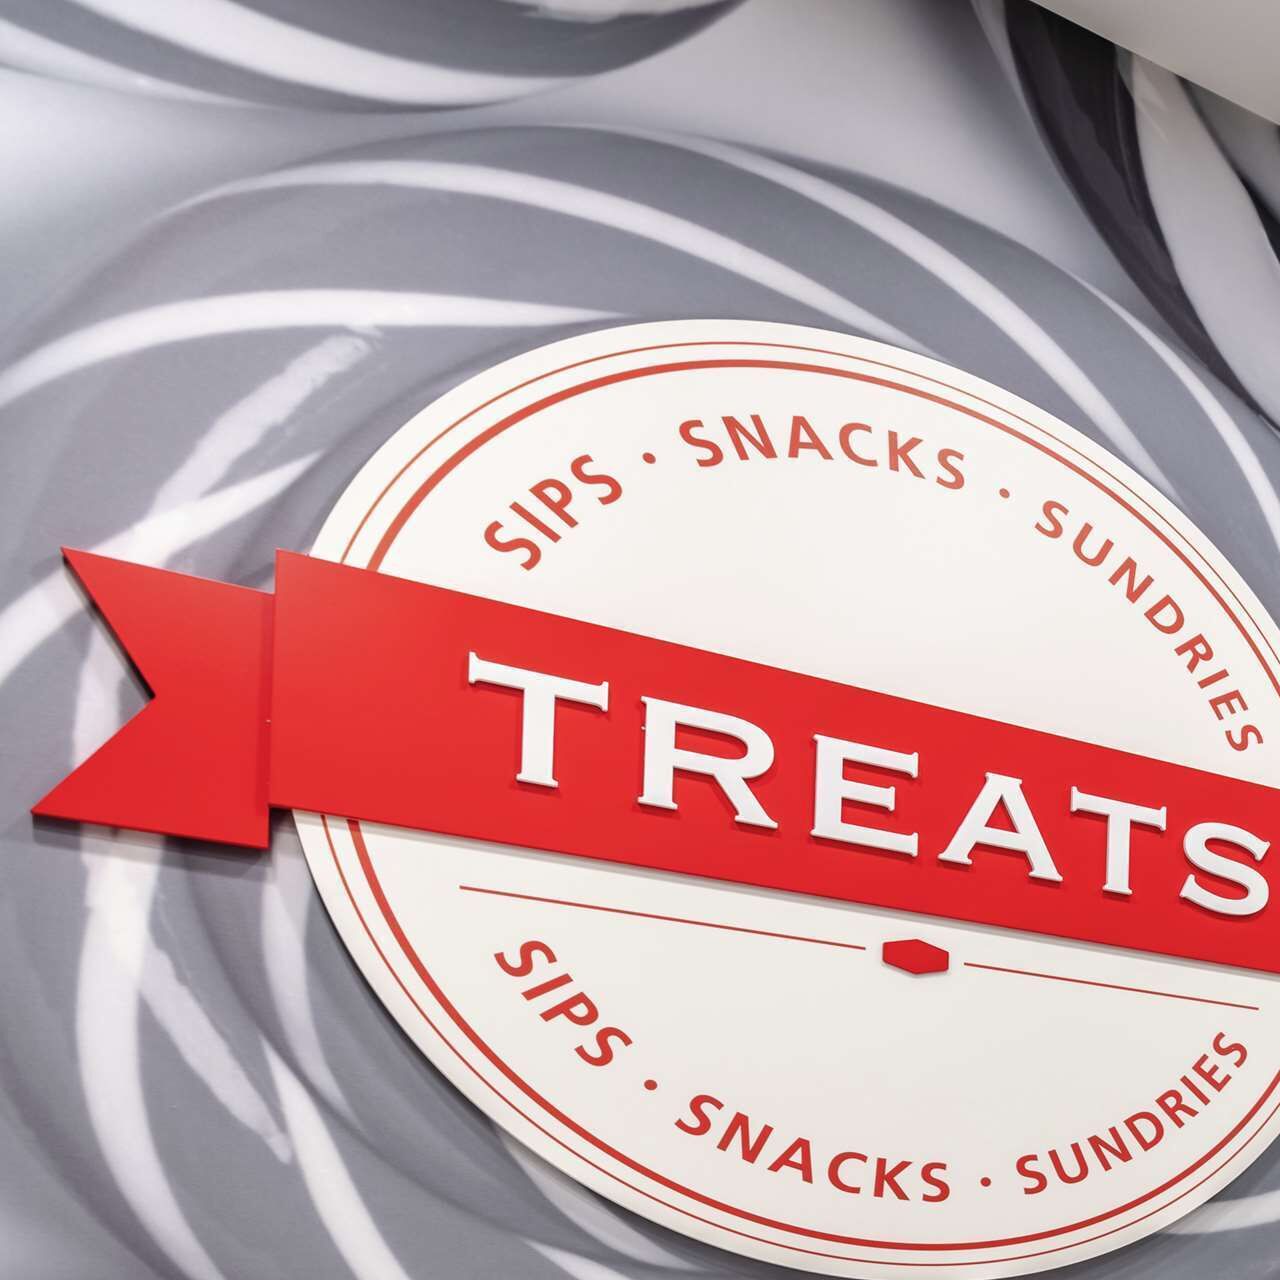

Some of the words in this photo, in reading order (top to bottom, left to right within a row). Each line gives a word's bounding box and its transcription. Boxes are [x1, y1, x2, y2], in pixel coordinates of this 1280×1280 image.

[483, 453, 624, 571] SIPS
[678, 413, 967, 491] SNACKS
[1033, 499, 1265, 754] SUNDRIES
[467, 650, 1272, 918] TREATS
[493, 938, 634, 1068] SIPS
[674, 1093, 952, 1203] SNACKS
[1014, 1029, 1250, 1196] SUNDRIES
